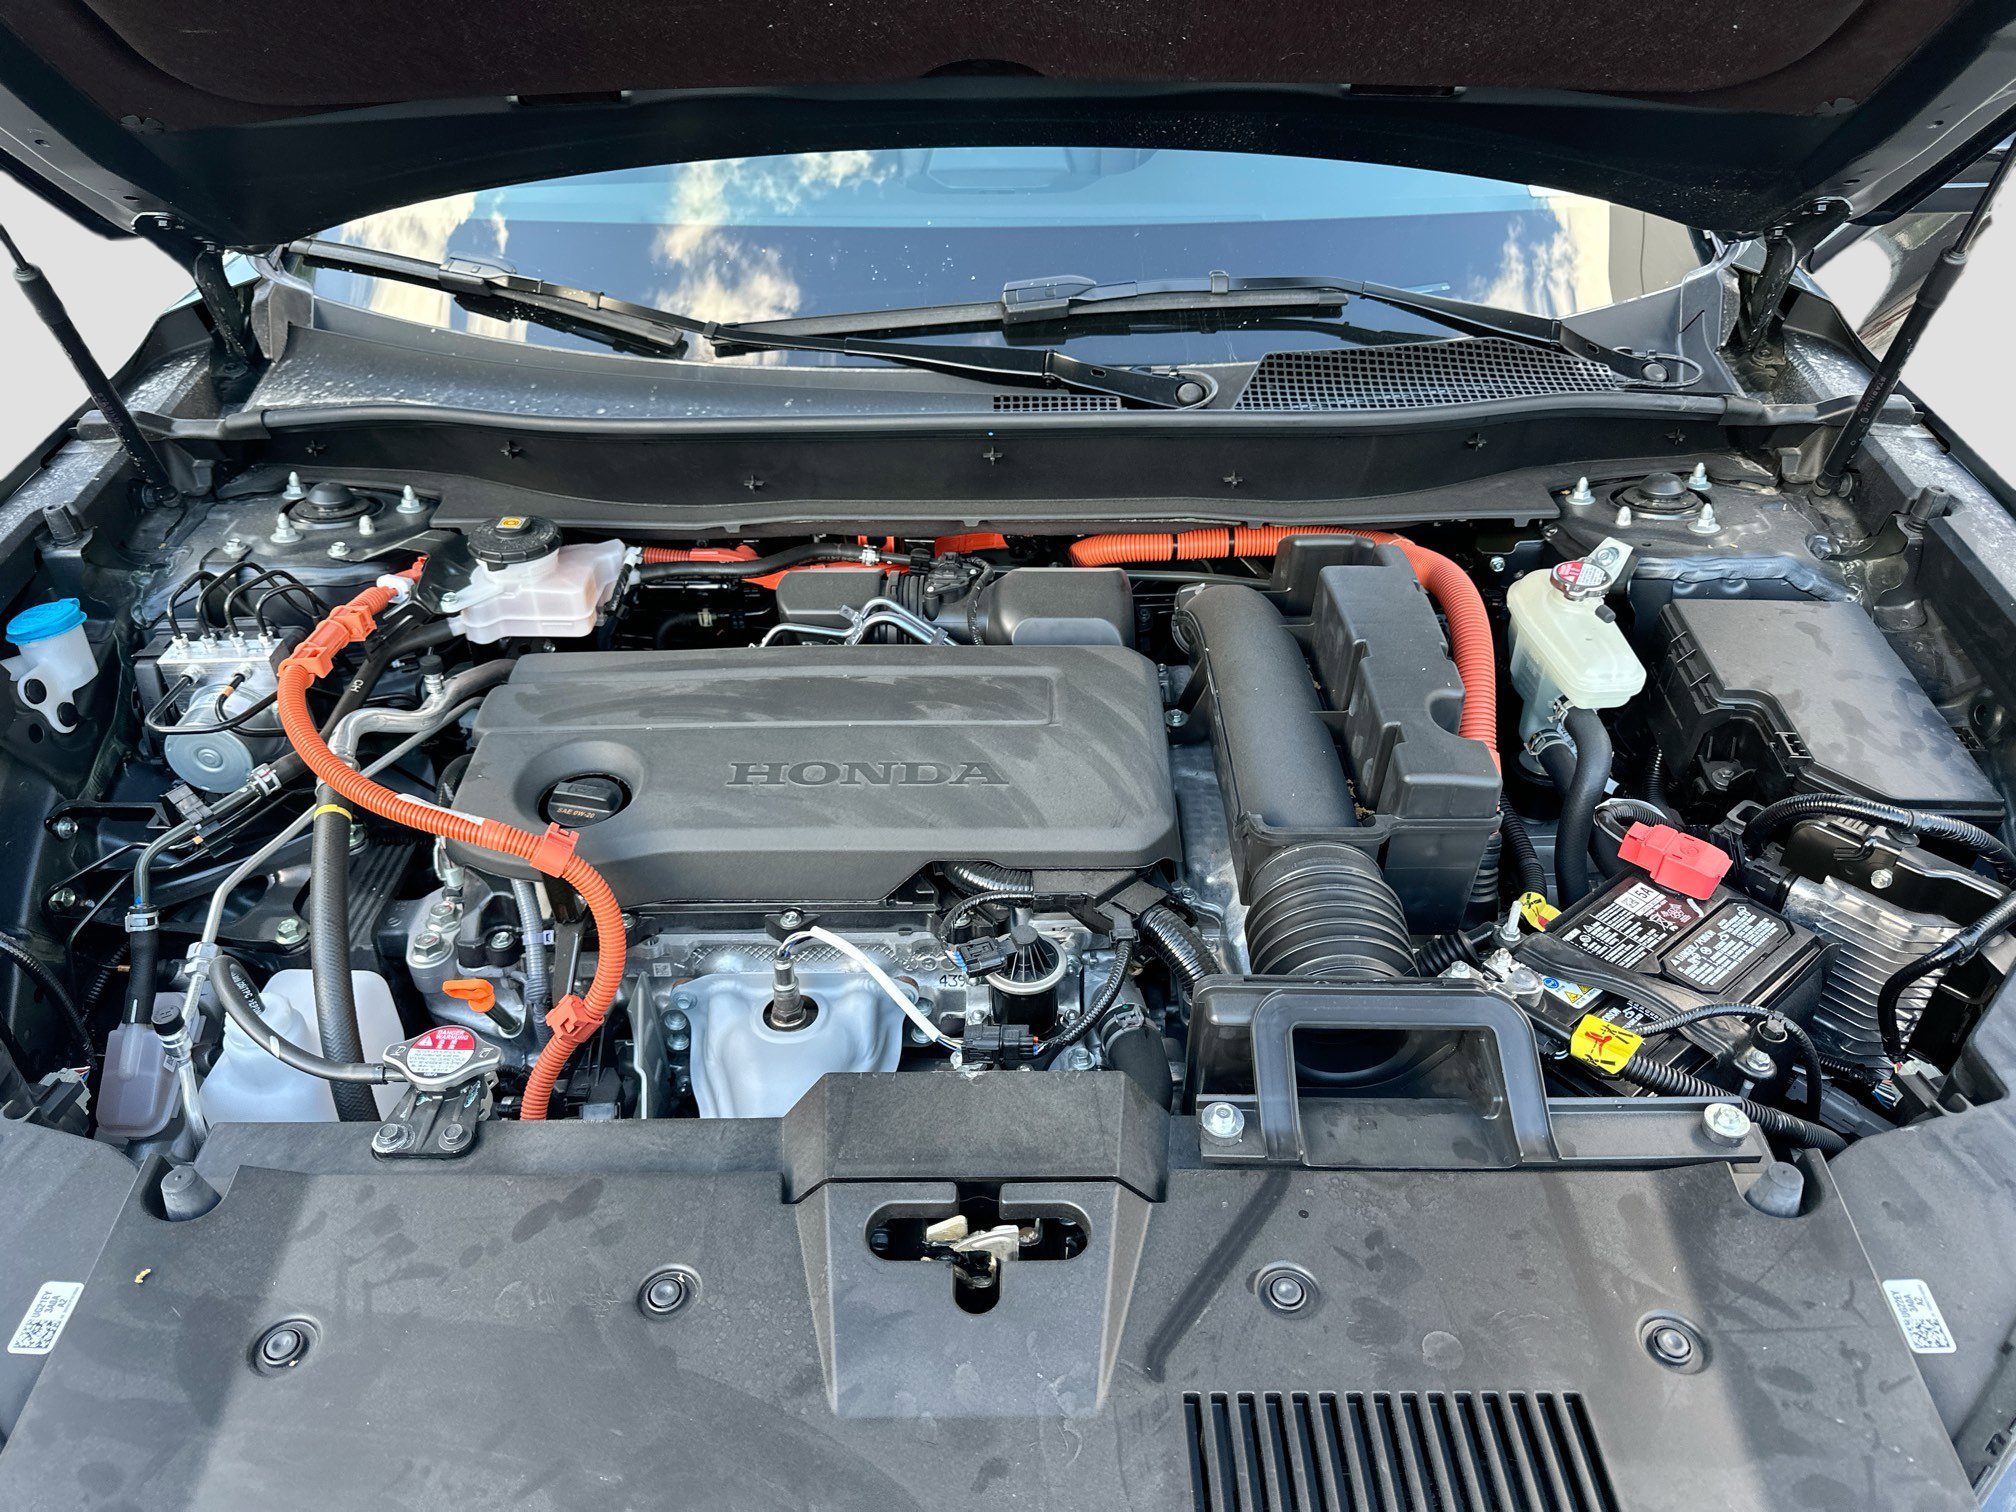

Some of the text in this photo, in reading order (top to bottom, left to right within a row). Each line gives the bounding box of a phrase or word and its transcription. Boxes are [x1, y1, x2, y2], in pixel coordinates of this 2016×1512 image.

[726, 761, 1010, 786] HONDA
[556, 807, 596, 819] SAE 0W-20
[1634, 886, 1654, 900] 5A
